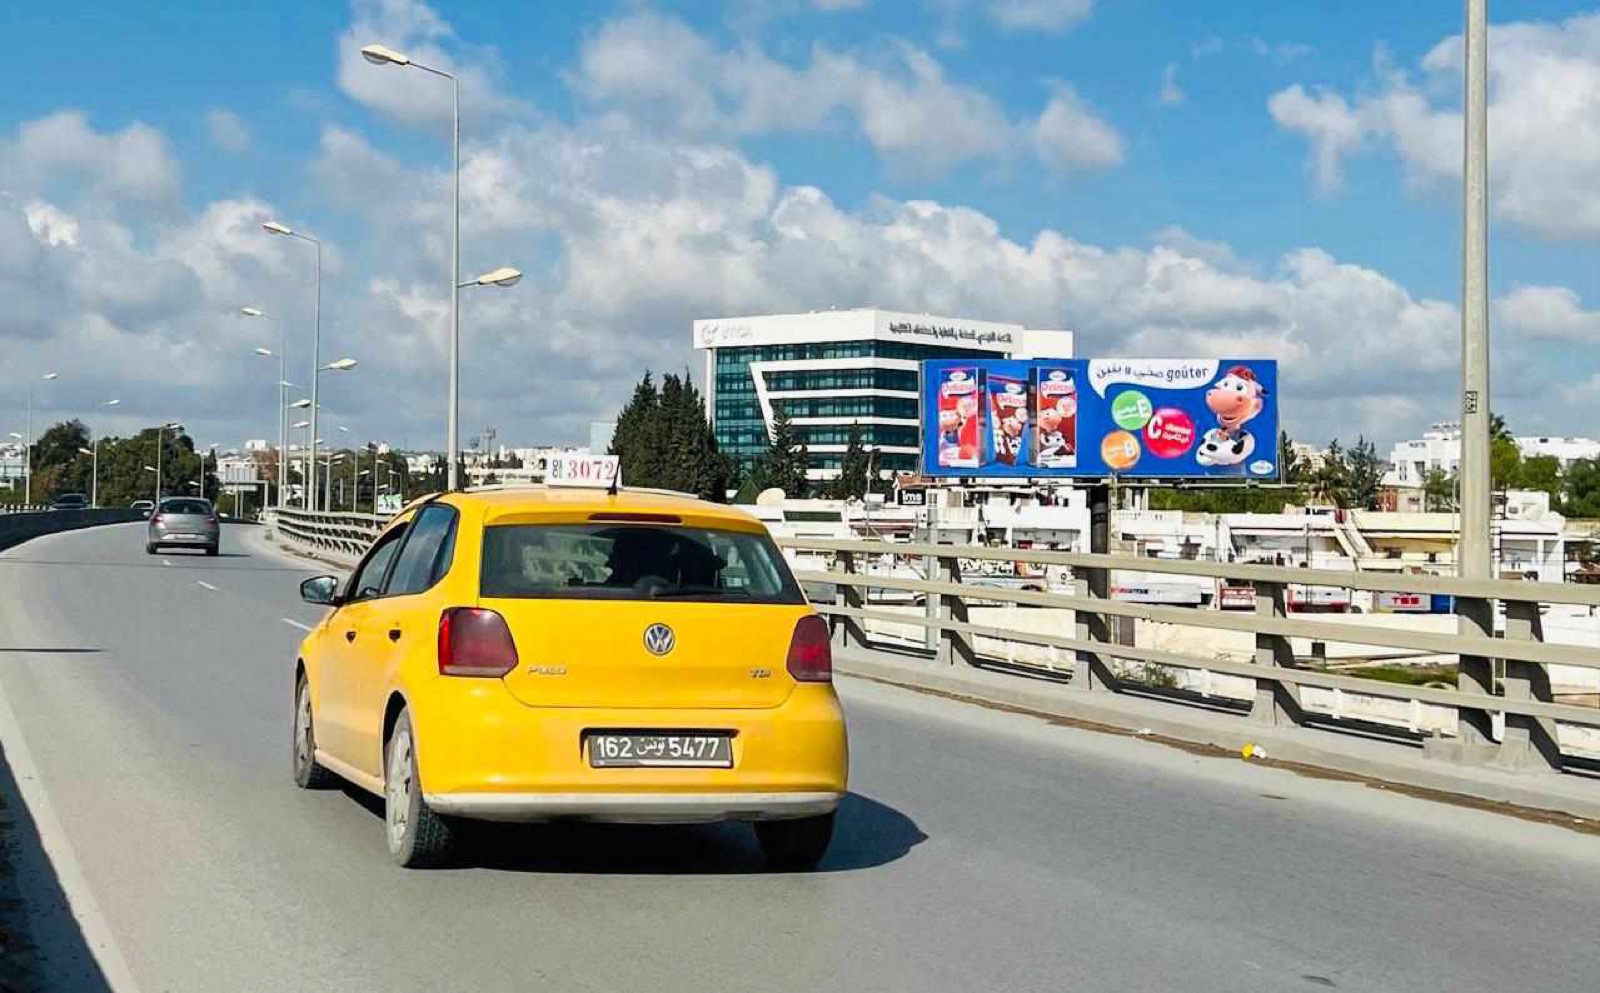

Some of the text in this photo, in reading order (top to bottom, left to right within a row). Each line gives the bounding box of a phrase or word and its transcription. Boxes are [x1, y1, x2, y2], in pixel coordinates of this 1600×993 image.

[1147, 415, 1163, 440] C
[567, 459, 616, 481] 3072
[597, 737, 720, 758] 162 تونس 5477
